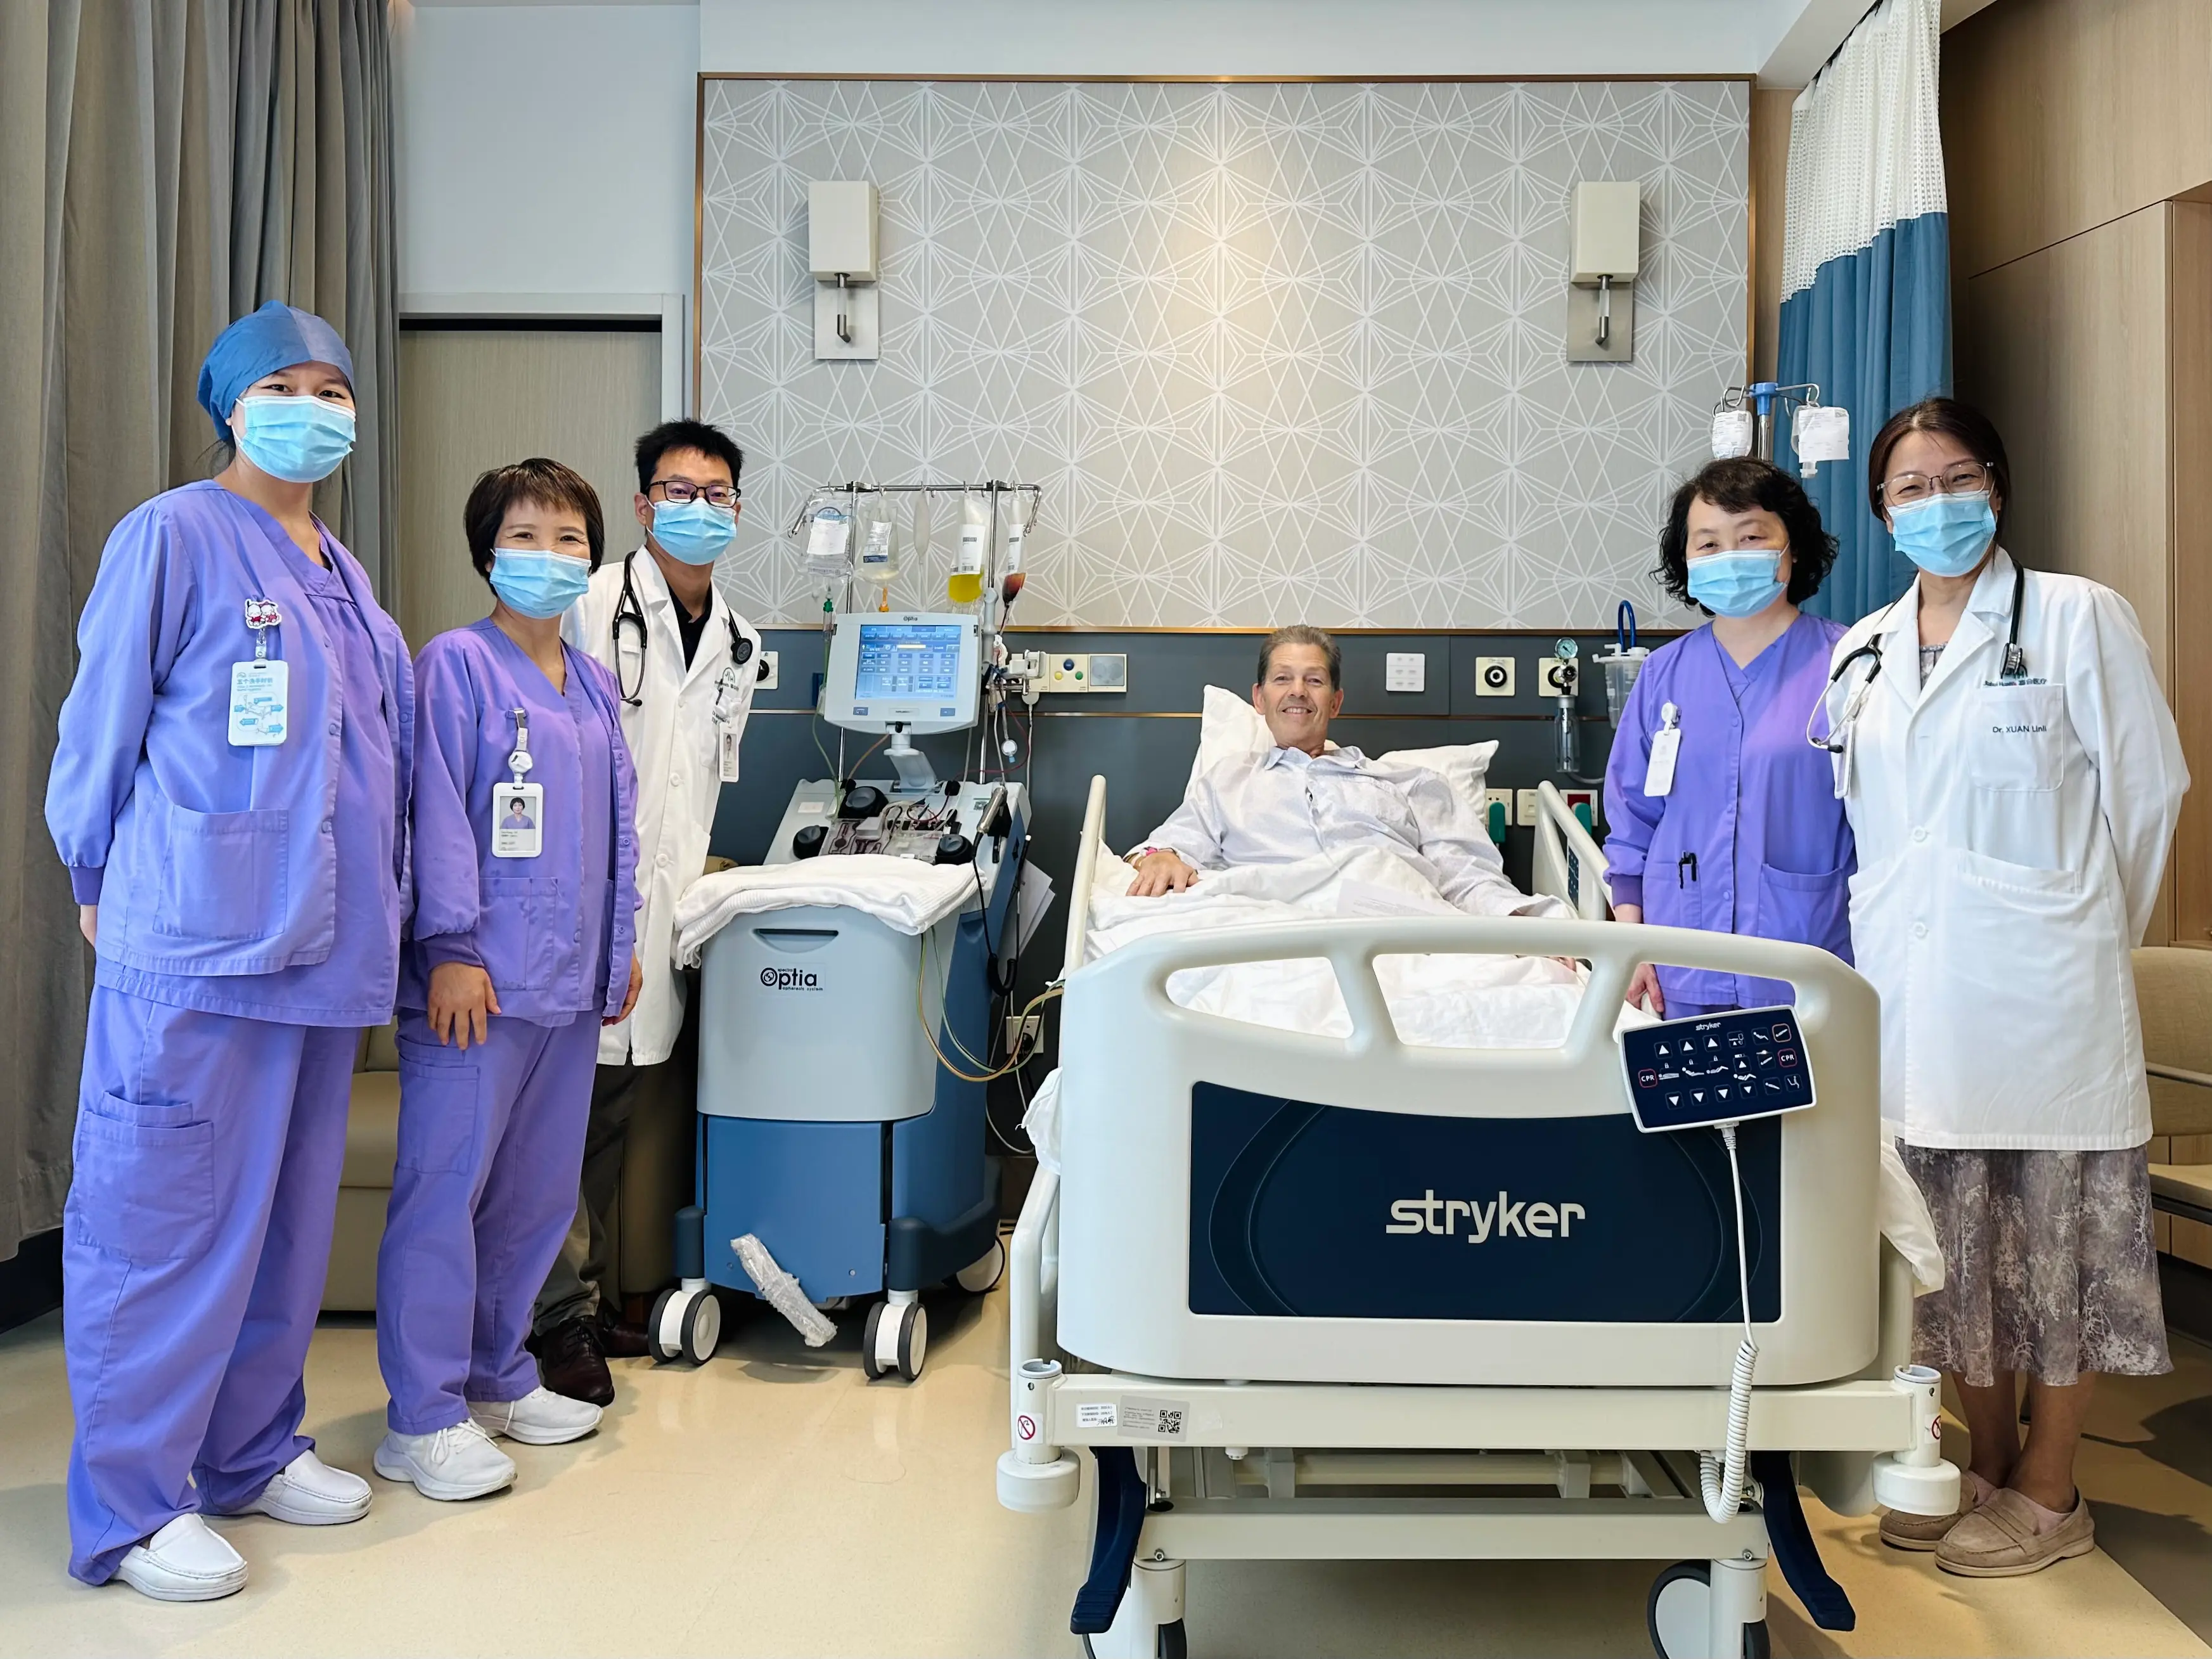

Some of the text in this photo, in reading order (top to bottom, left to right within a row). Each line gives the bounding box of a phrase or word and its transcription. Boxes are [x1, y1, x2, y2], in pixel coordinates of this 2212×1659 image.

[761, 967, 817, 990] Optia
[1695, 1022, 1721, 1031] stryker
[1386, 1189, 1586, 1244] stryker
